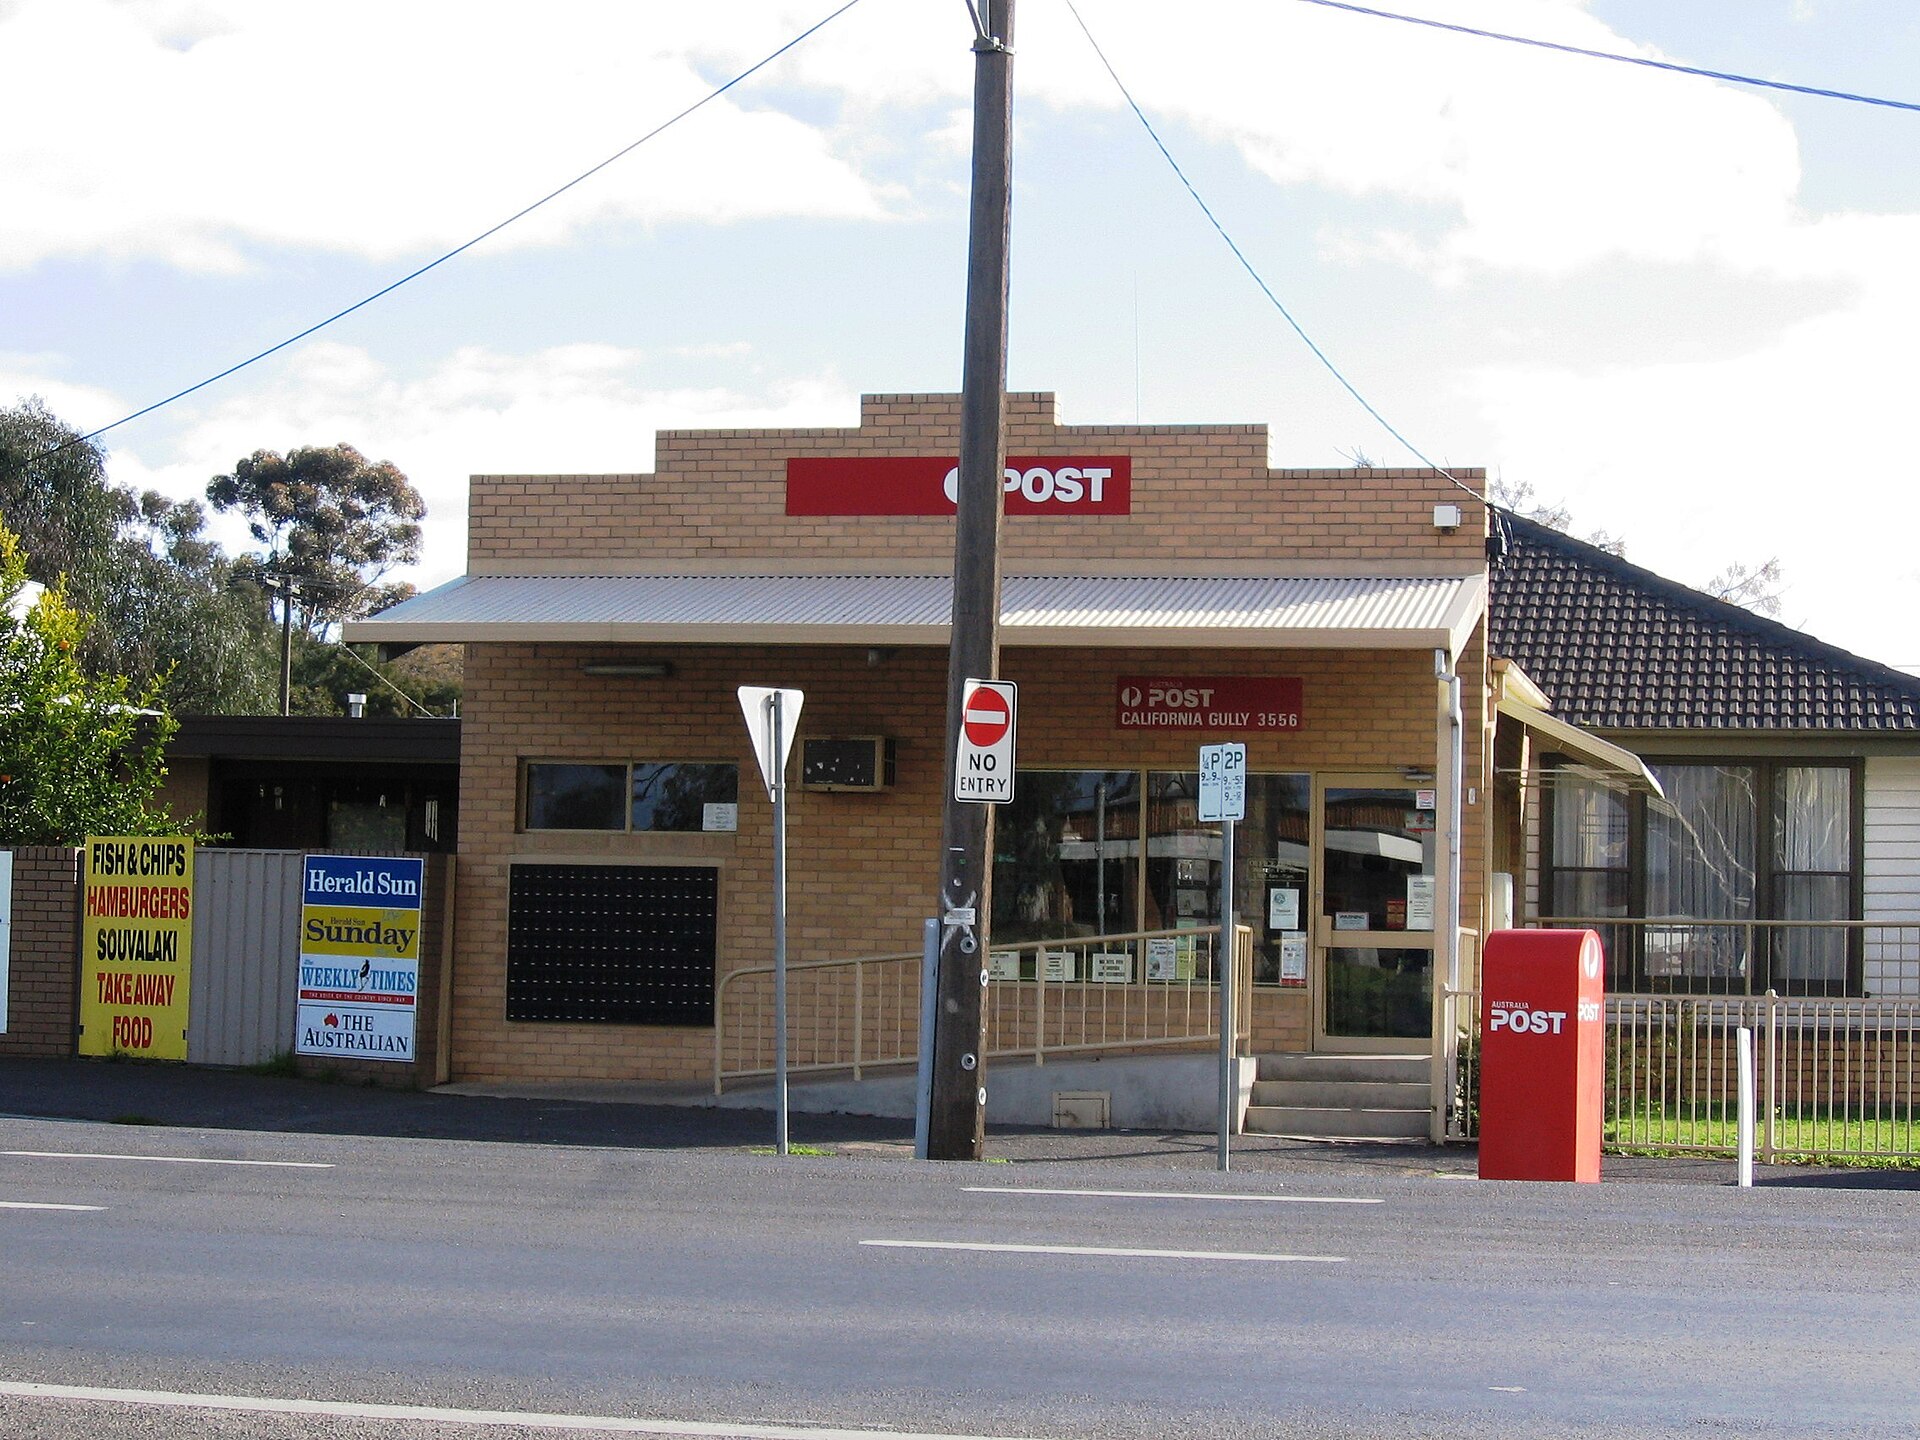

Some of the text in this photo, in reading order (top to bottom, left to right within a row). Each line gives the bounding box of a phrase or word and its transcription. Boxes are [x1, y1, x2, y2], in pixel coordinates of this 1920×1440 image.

[1148, 688, 1215, 708] POST
[1121, 712, 1298, 727] CALIFORNIA GULLY 3556
[969, 753, 997, 772] NO
[1224, 751, 1243, 770] 2P
[960, 776, 1007, 793] ENTRY
[92, 842, 186, 877] FISH & CHIPS
[307, 869, 417, 896] Herald Sun
[87, 885, 190, 920] HAMBURGERS
[330, 916, 366, 926] Herald Sun
[96, 928, 178, 963] SOUVALAKI
[306, 918, 416, 953] Sunday
[96, 972, 175, 1007] TAKE AWAY
[301, 966, 415, 993] WEEKLY TIMES
[1492, 1001, 1529, 1009] AUSTRALIA
[1578, 1003, 1600, 1021] POST
[112, 1015, 153, 1050] FOOD
[342, 1014, 374, 1032] THE
[1491, 1010, 1566, 1034] POST
[303, 1027, 409, 1053] AUSTRALIAN
